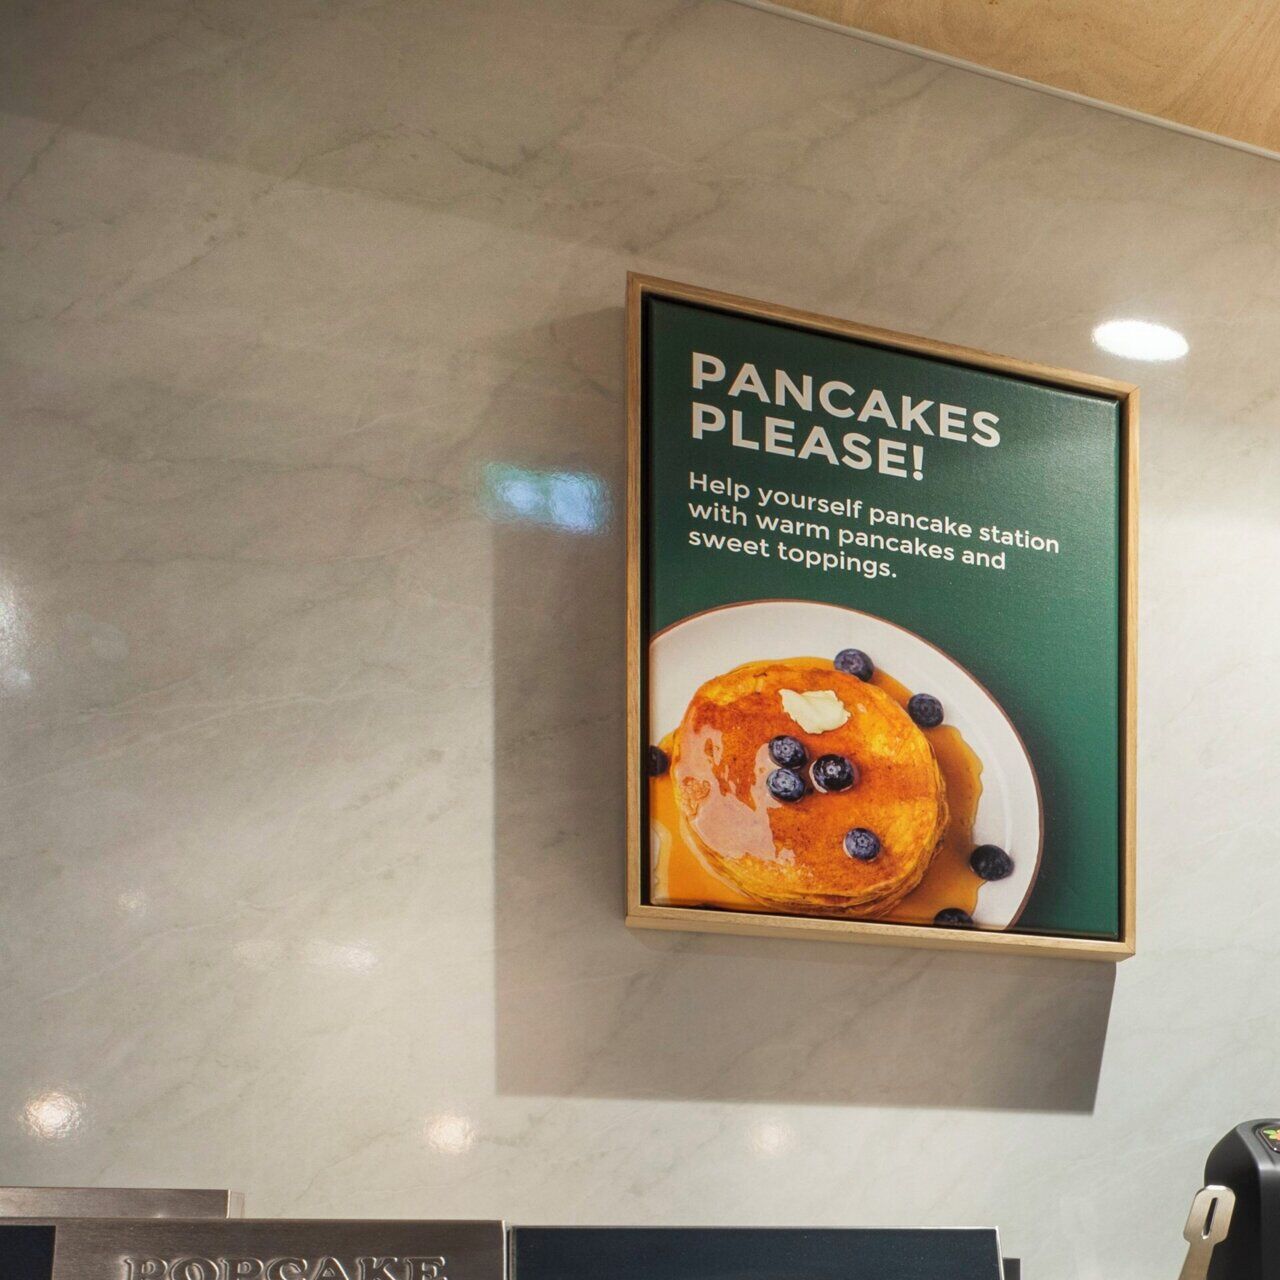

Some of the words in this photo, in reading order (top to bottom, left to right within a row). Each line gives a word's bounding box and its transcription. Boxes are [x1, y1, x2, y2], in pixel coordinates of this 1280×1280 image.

[692, 351, 1001, 448] PANCAKES
[692, 401, 924, 481] PLEASE!
[688, 502, 748, 526] with
[755, 514, 830, 540] warm
[838, 528, 955, 561] pancakes
[961, 549, 1006, 570] and
[689, 471, 750, 502] Help
[757, 487, 863, 519] yourself
[869, 507, 973, 538] pancake
[978, 525, 1060, 554] station
[688, 530, 770, 558] sweet
[777, 541, 897, 579] toppings.
